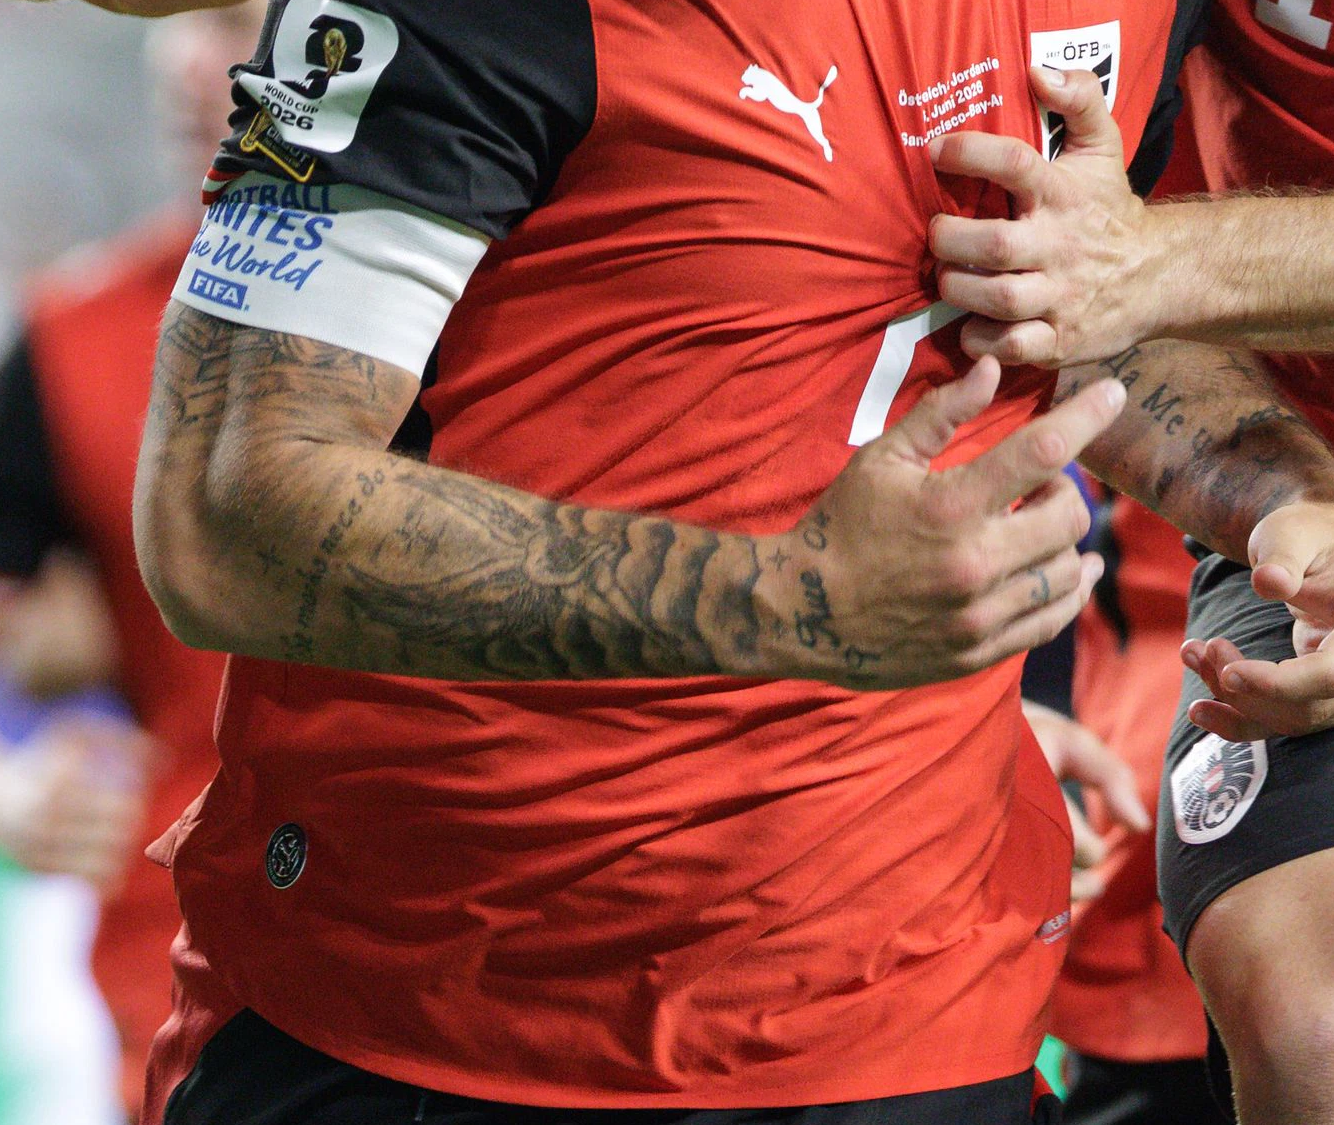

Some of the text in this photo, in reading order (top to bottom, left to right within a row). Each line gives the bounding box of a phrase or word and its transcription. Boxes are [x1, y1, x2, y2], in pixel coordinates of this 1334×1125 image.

[1063, 41, 1099, 61] ÖFB
[264, 82, 294, 106] WORLD
[294, 102, 319, 115] CUP
[931, 94, 956, 118] Juni
[955, 79, 984, 104] 2026
[211, 235, 323, 291] World
[193, 275, 239, 304] FIFA
